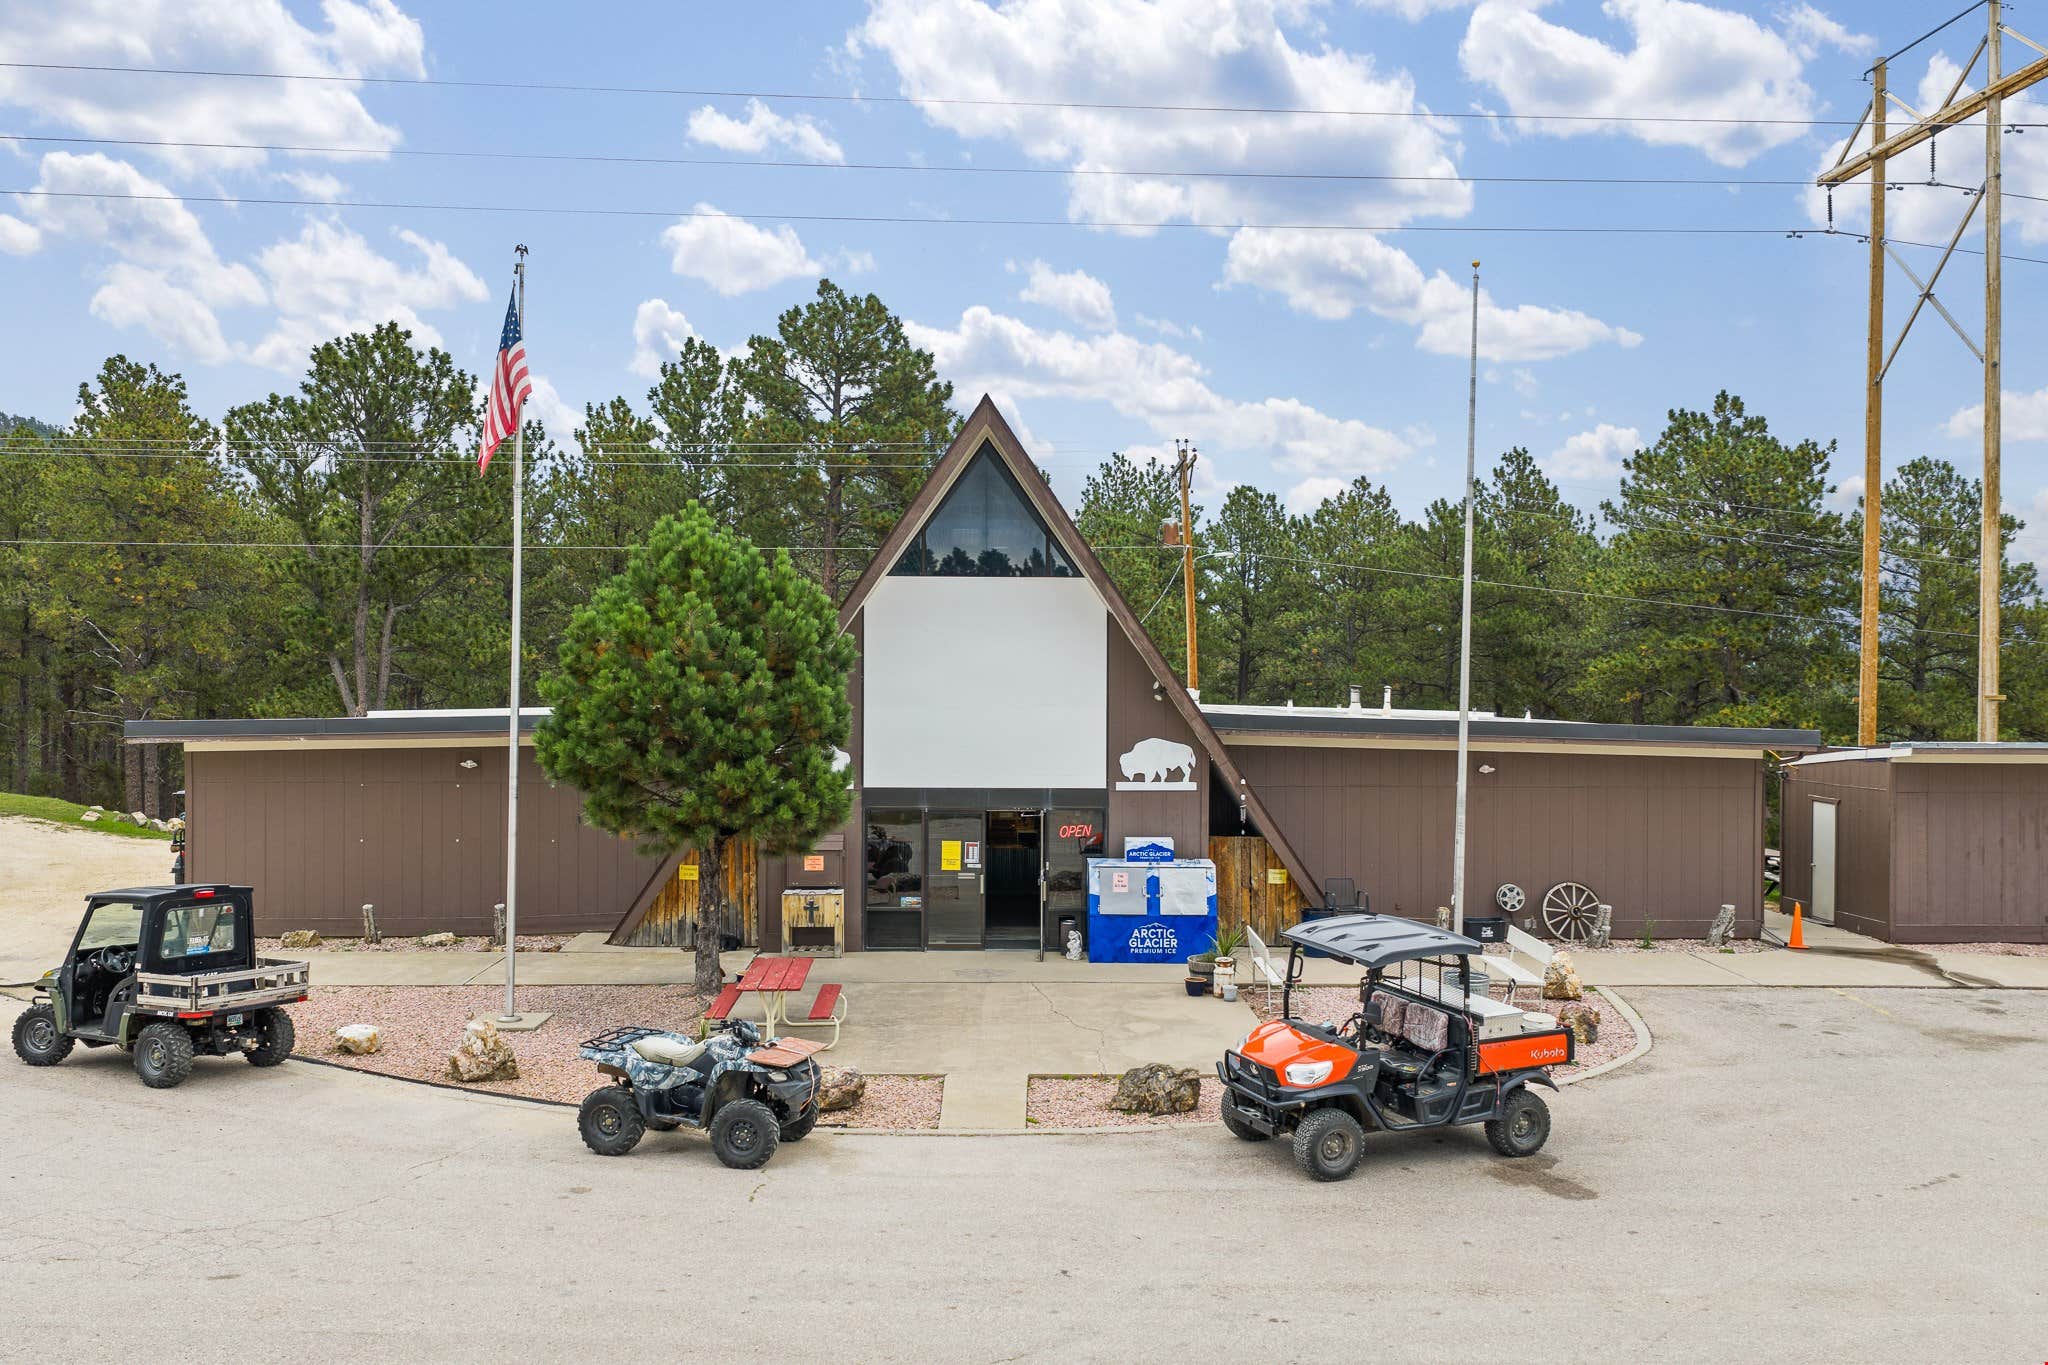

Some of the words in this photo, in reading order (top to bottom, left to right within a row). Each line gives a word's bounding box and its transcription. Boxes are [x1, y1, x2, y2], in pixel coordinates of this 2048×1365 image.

[1059, 824, 1092, 838] OPEN
[1132, 929, 1175, 938] ARCTIC
[1129, 938, 1178, 948] GLACIER
[1530, 1047, 1565, 1059] Kubota
